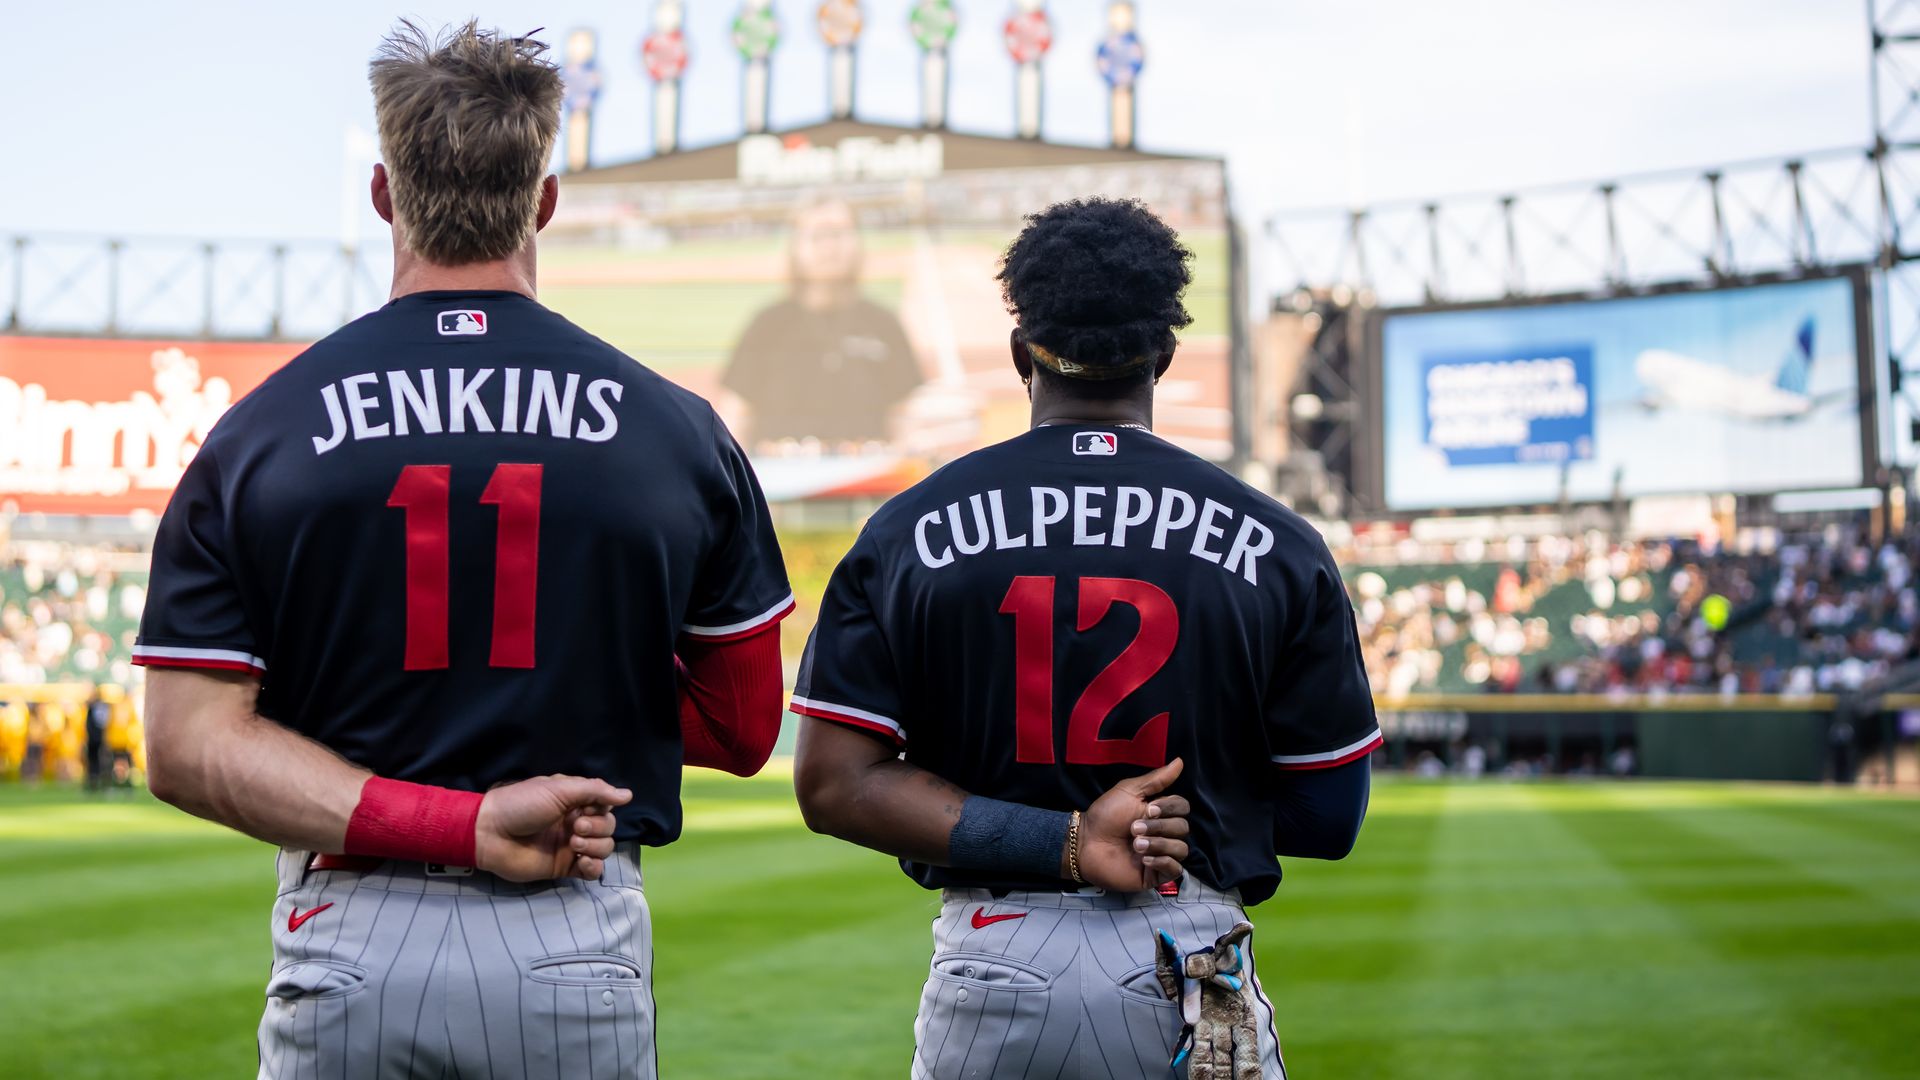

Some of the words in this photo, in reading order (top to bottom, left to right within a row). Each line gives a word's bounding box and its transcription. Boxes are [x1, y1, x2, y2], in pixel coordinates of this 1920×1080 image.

[312, 367, 624, 456] JENKINS
[387, 463, 543, 671] 11
[914, 486, 1275, 587] CULPEPPER
[998, 575, 1180, 767] 12
